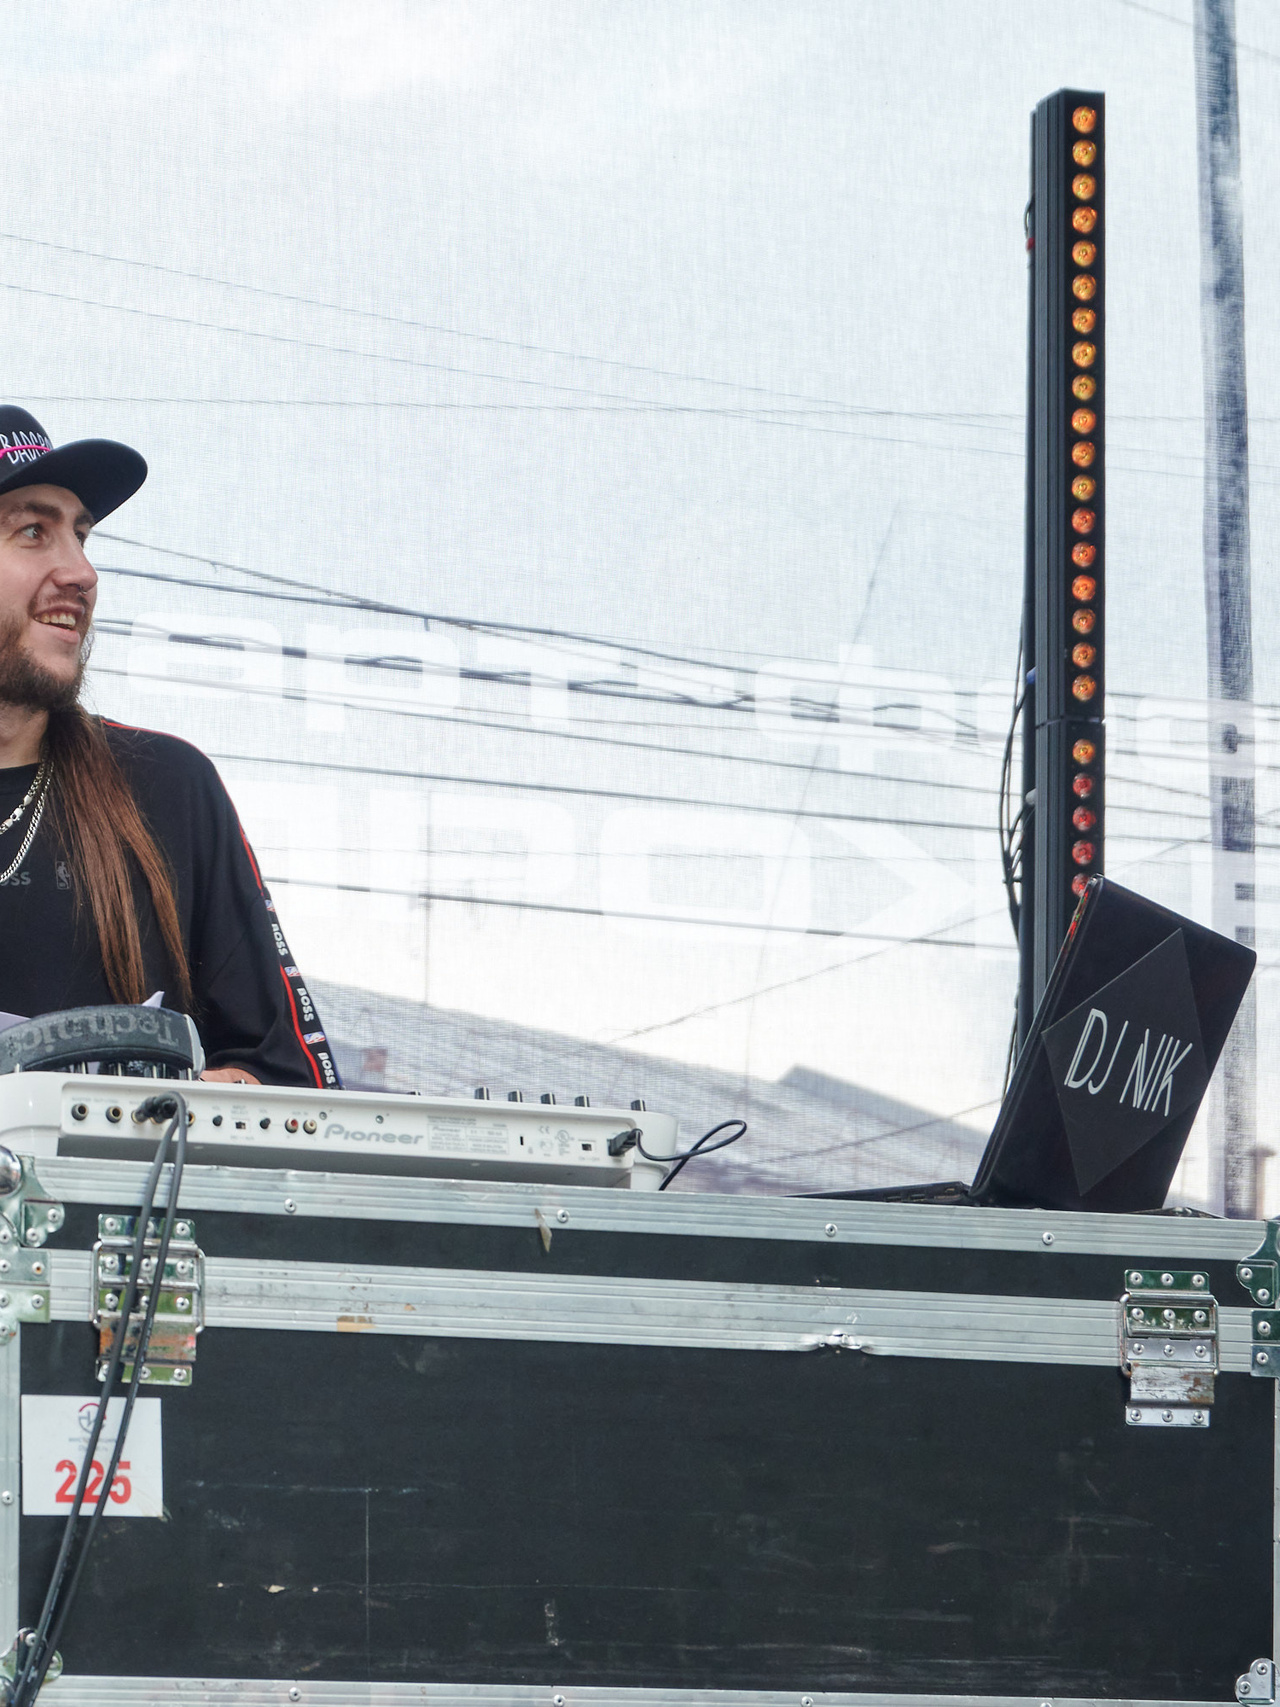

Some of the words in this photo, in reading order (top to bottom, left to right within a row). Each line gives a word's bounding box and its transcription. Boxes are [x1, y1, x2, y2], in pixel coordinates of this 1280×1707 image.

[271, 923, 289, 956] BOSS
[297, 987, 315, 1022] BOSS
[317, 1052, 337, 1085] BOSS
[1064, 1008, 1129, 1095] DJ
[1119, 1028, 1193, 1117] NIK
[324, 1122, 424, 1145] Pioneer
[55, 1459, 132, 1505] 225
